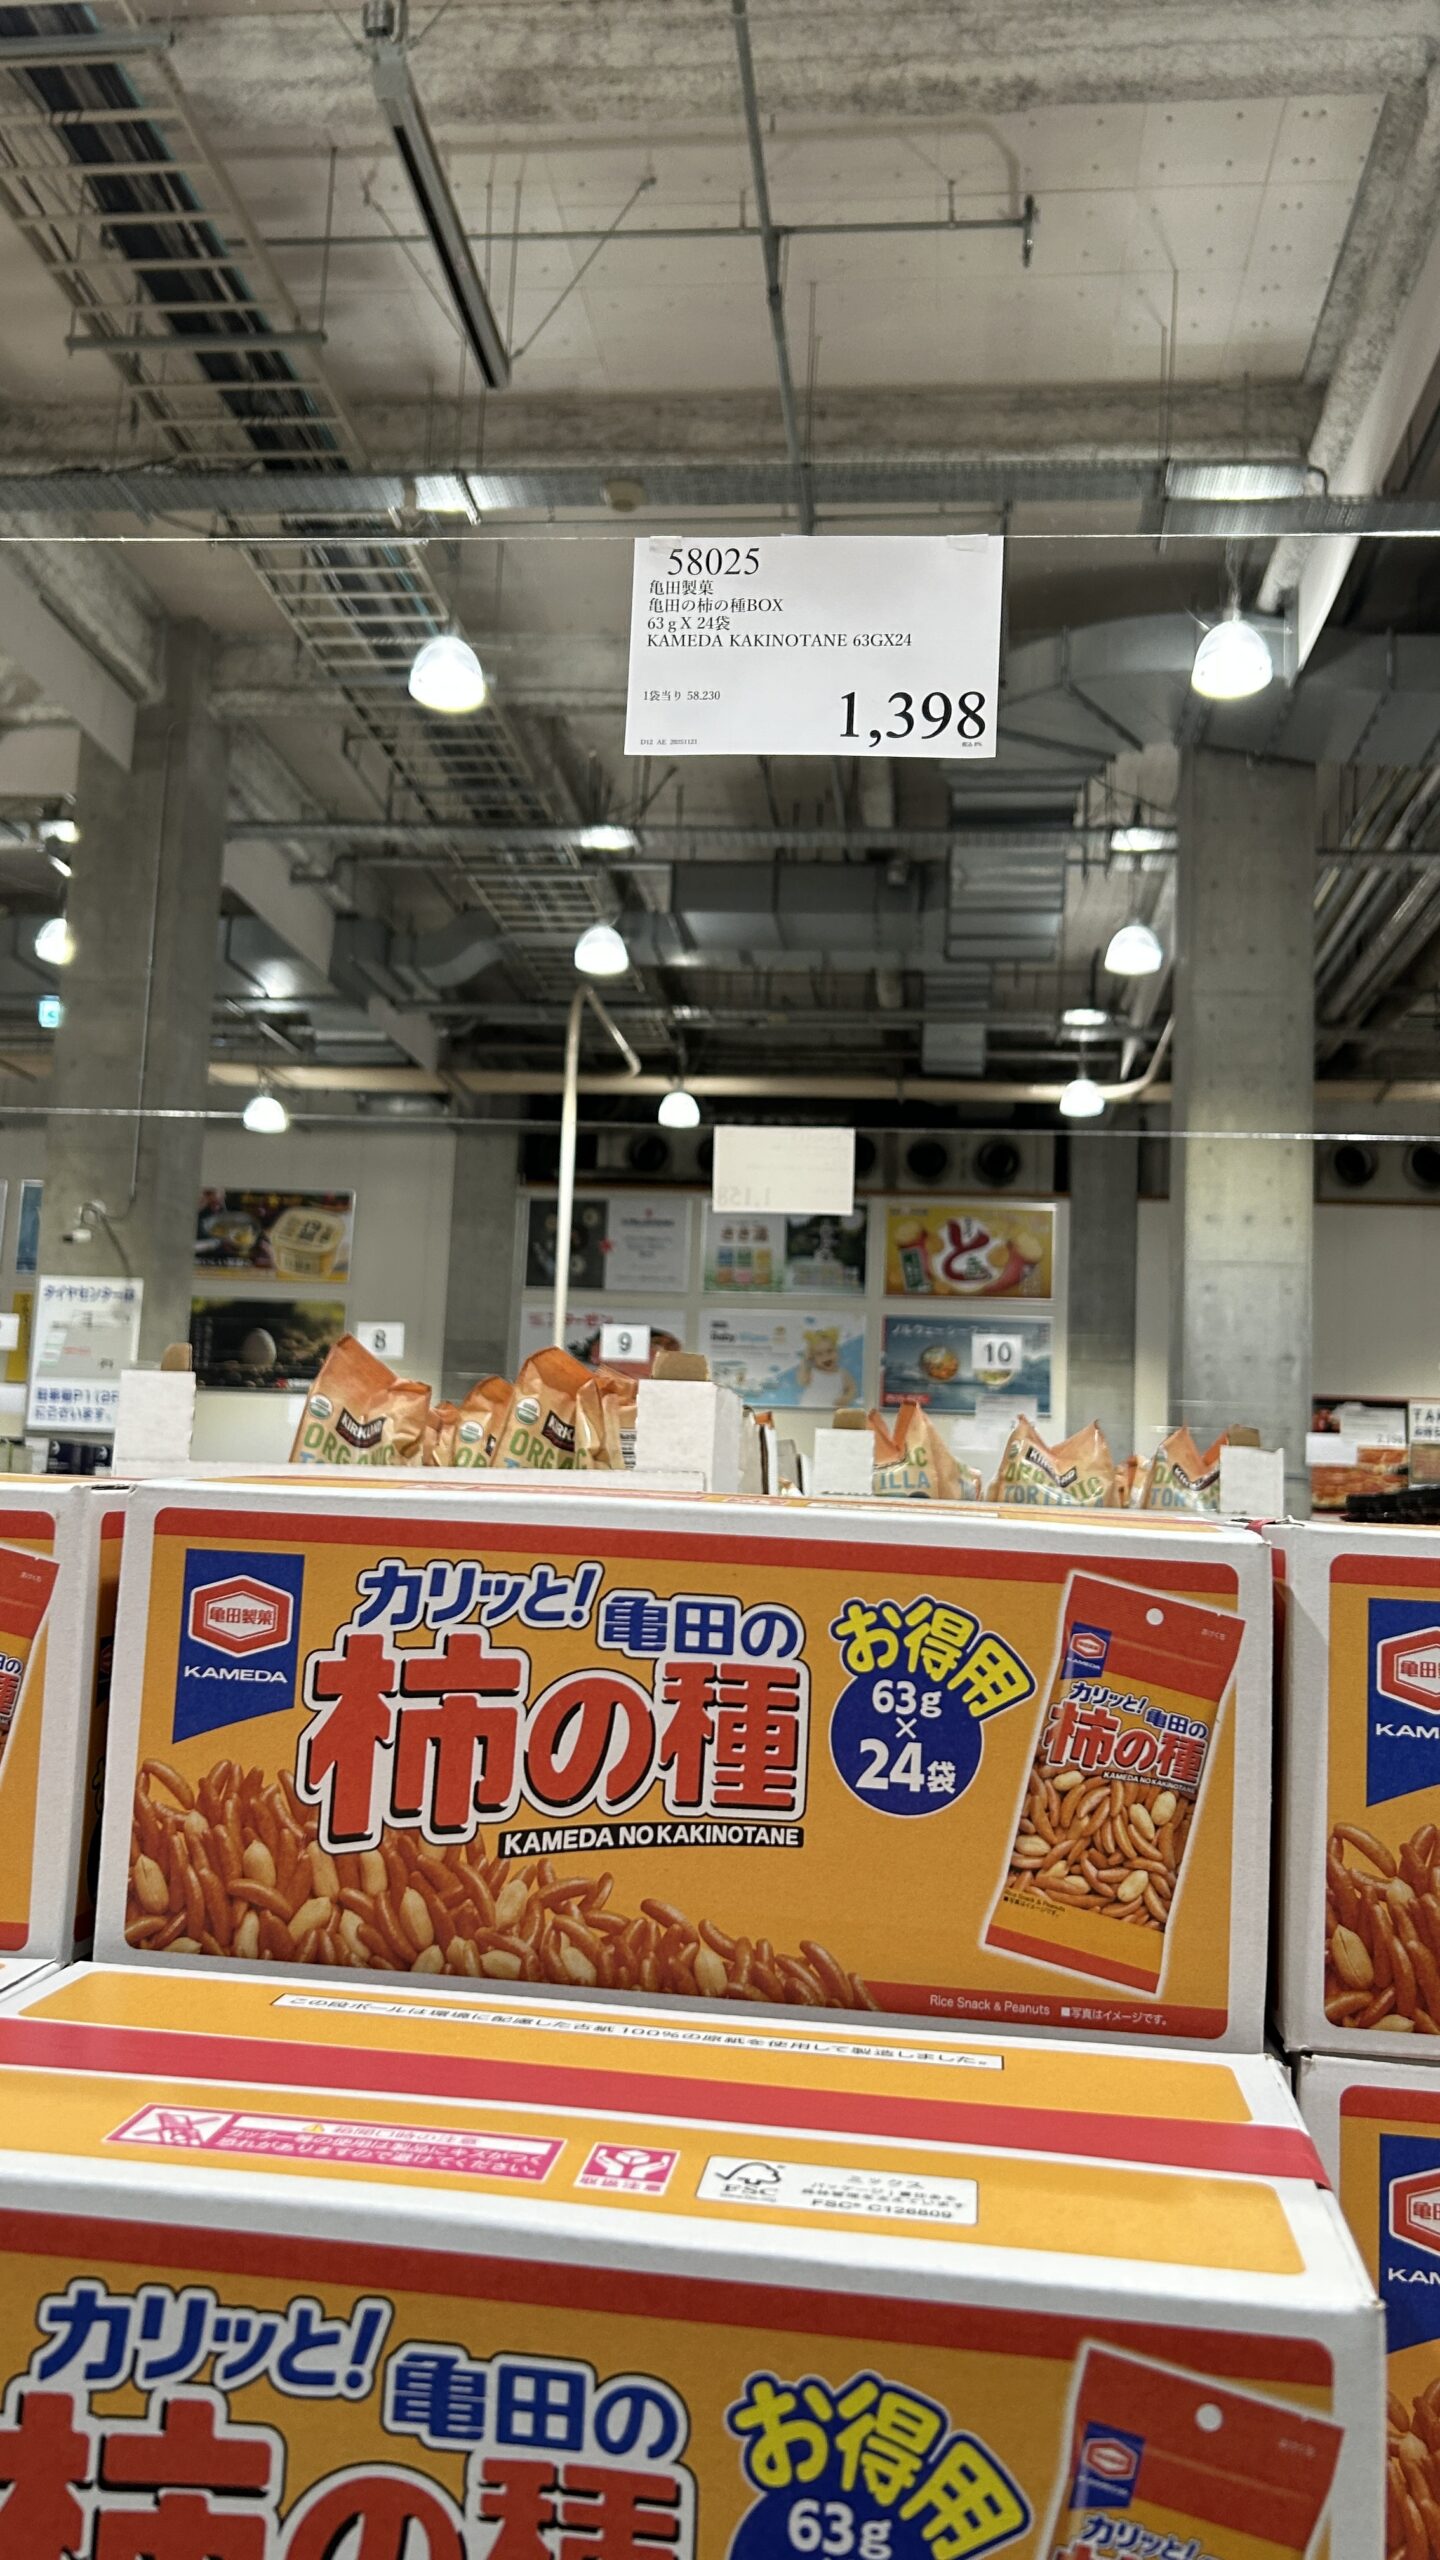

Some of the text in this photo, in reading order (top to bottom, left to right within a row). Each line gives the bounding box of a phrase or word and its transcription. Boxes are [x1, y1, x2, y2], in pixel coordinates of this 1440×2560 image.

[667, 547, 760, 576] 58025
[649, 579, 714, 596] 亀田製菓
[649, 597, 783, 613] 亀田の柿の種BOX
[647, 633, 912, 647] KAMEDA KAKINOTANE 63GX24
[643, 690, 721, 702] 1袋当り 58.230
[840, 691, 986, 748] 1,398
[374, 1328, 386, 1350] 8
[617, 1331, 632, 1351] 9
[984, 1341, 1012, 1363] 10
[357, 1564, 597, 1628] カリッと!
[209, 1606, 275, 1626] 亀田製菓
[603, 1596, 799, 1659] 亀田の
[184, 1665, 288, 1684] KAMEDA
[834, 1600, 1031, 1718] お得用
[871, 1679, 943, 1718] 63g
[308, 1630, 799, 1840] 柿の種
[1146, 1709, 1208, 1740] 亀田の
[1044, 1701, 1206, 1784] 柿の種
[855, 1739, 957, 1795] 24袋
[1103, 1772, 1139, 1783] KAMEDA
[503, 1824, 800, 1856] KAMEDA NO KAKINOTANE
[930, 1994, 1050, 2016] Rice Snack & Peanuts
[38, 2289, 387, 2392] カリッと!
[392, 2351, 680, 2460] 亀田の
[734, 2379, 1024, 2560] お得用
[787, 2499, 892, 2560] 63g
